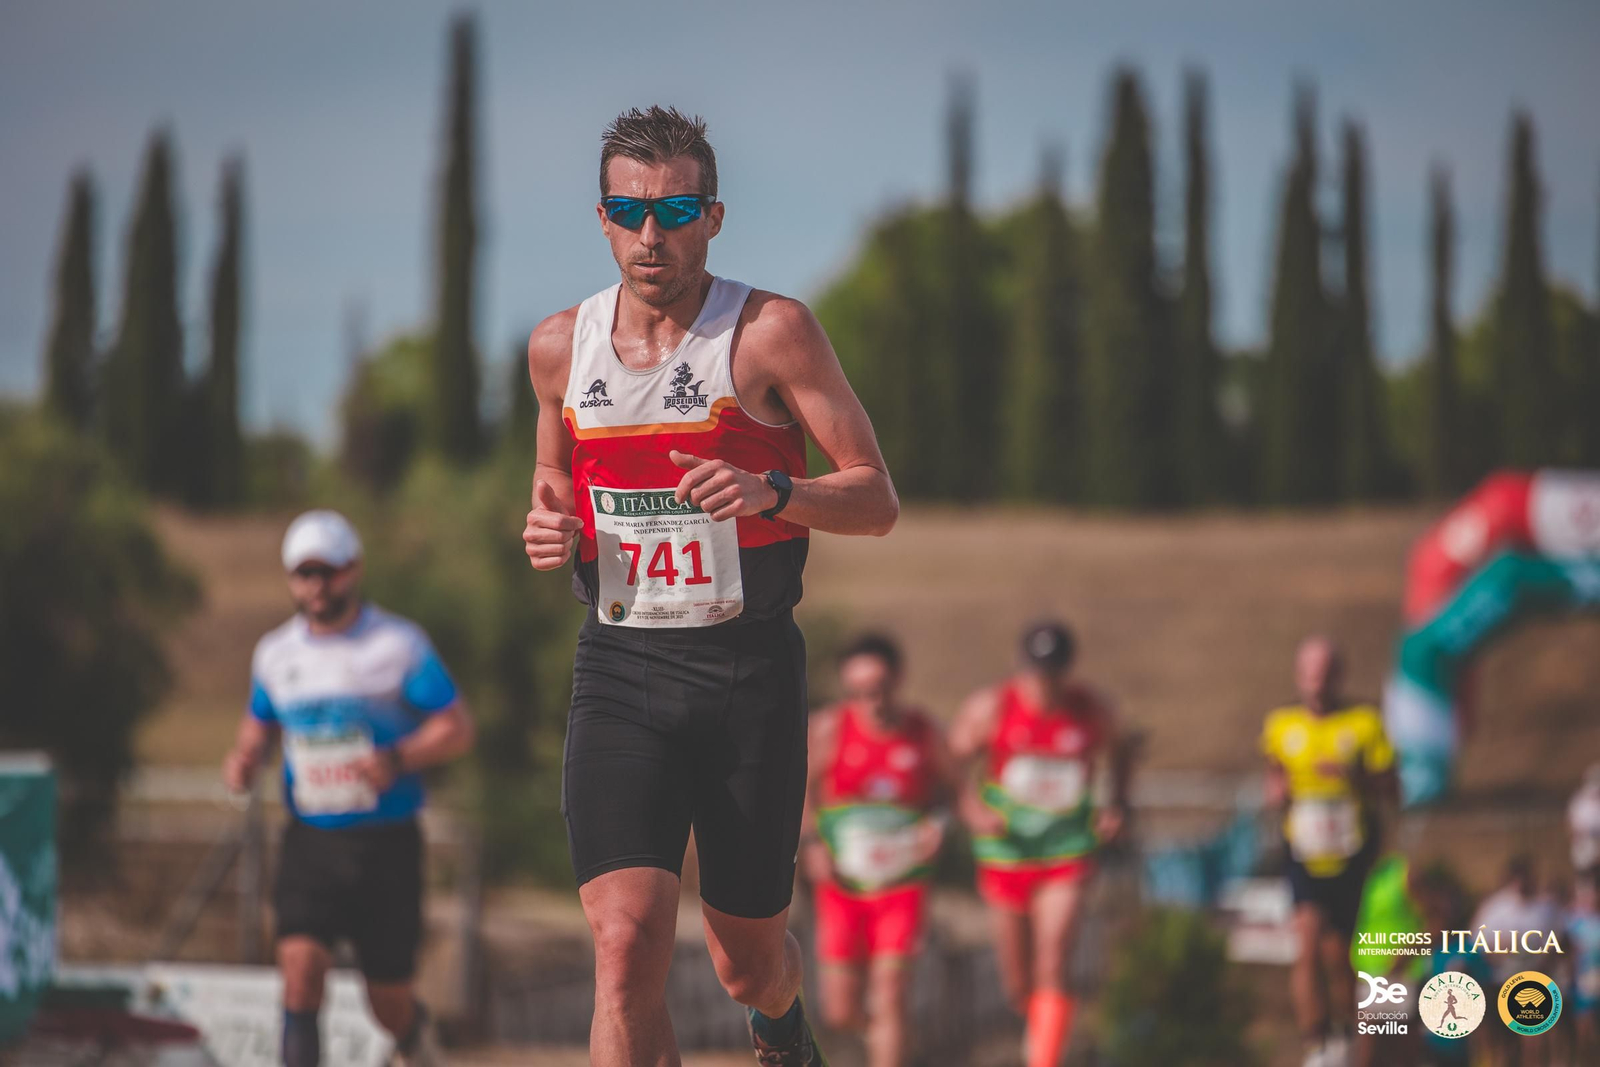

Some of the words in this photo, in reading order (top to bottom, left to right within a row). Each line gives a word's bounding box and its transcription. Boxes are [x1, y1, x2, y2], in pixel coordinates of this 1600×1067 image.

[666, 396, 706, 407] POSEIDON
[622, 494, 692, 512] ITÁLICA
[684, 517, 710, 526] GARCÍA
[633, 527, 684, 535] INDEPENDIENTE
[619, 540, 712, 586] 741
